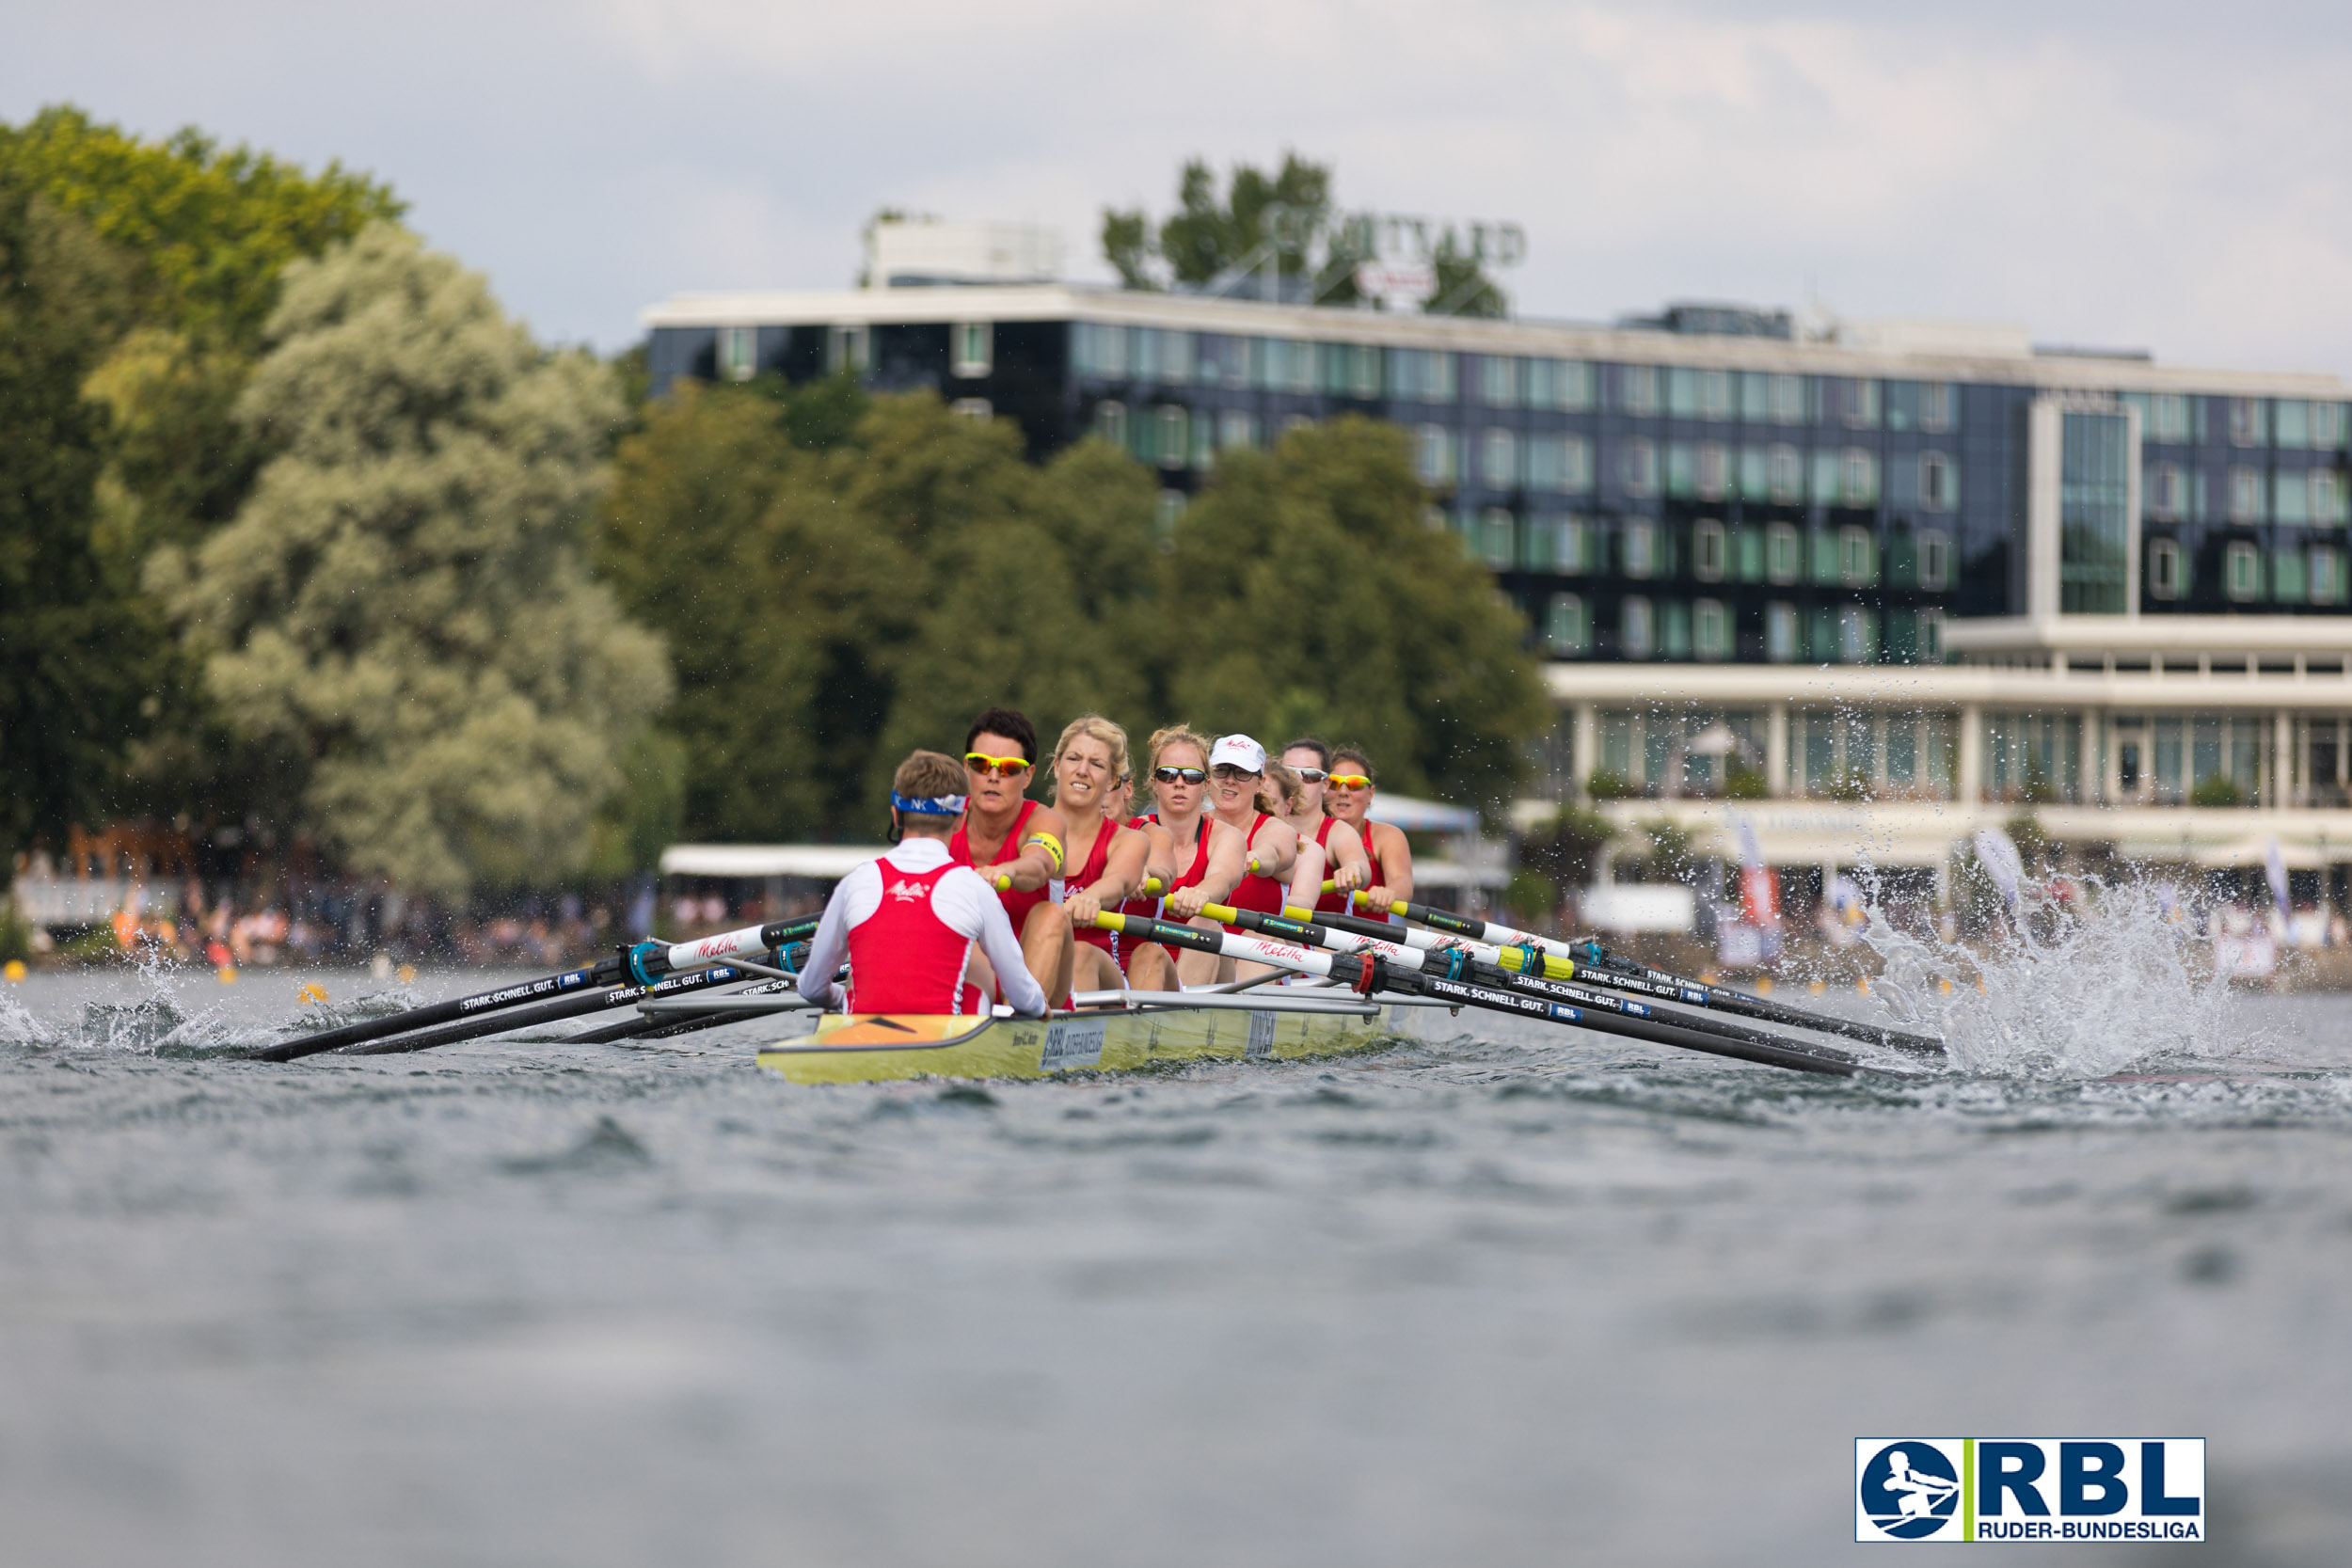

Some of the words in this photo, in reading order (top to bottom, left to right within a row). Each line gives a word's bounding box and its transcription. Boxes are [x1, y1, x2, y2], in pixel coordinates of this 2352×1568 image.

[693, 933, 742, 961] Melitta
[1250, 939, 1306, 963] Melitta
[564, 973, 580, 984] RBL
[713, 968, 730, 978] RBL
[1581, 970, 1612, 984] STARK.
[1613, 976, 1655, 992] SCHNELL.
[1656, 985, 1677, 997] GUT.
[1647, 970, 1675, 985] STARK.
[463, 994, 494, 1010] STARK.
[493, 985, 534, 1004] SCHNELL.
[533, 979, 554, 993] GUT.
[609, 987, 639, 1002] STARK.
[640, 978, 681, 995] SHNELL.
[682, 974, 703, 986] GUT.
[1436, 981, 1470, 997] STARK.
[1471, 989, 1519, 1007] SCHNELL.
[1520, 999, 1545, 1013] GUT.
[1517, 975, 1549, 991] STARK.
[1550, 984, 1594, 1003] SCHNELL.
[1595, 995, 1616, 1007] GUT.
[1687, 990, 1704, 1001] RBL
[1557, 1006, 1576, 1018] RBL
[1628, 1003, 1645, 1013] RBL
